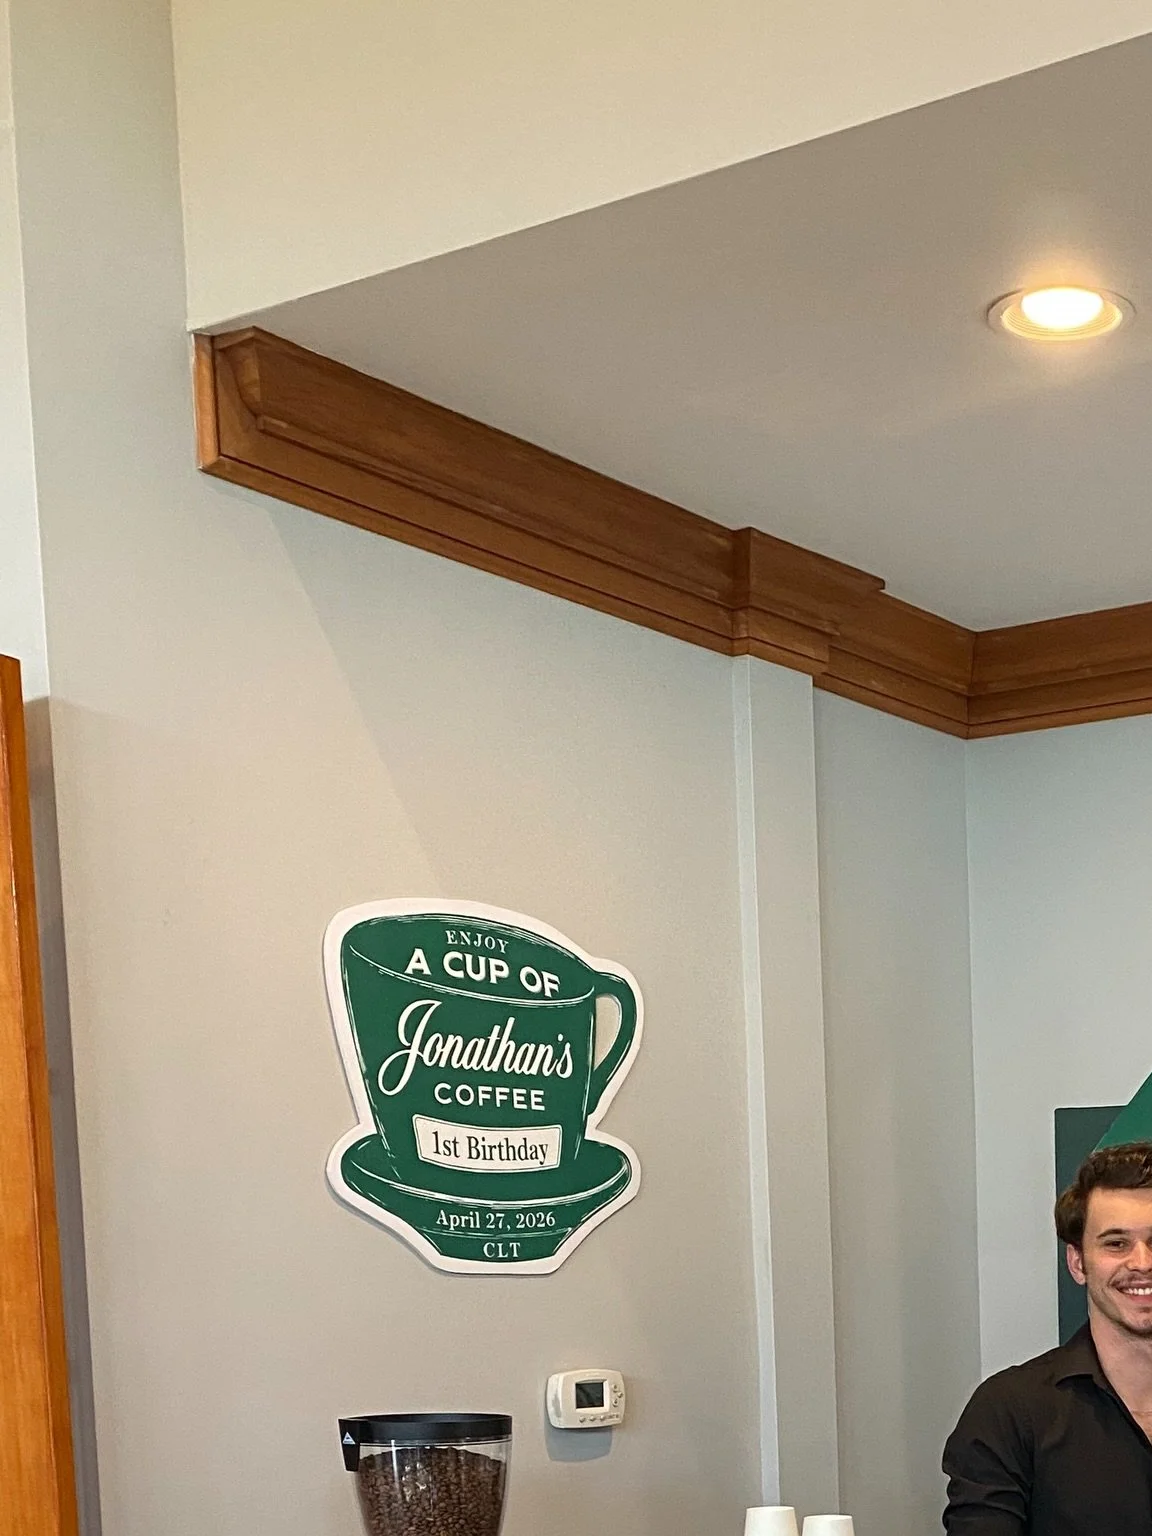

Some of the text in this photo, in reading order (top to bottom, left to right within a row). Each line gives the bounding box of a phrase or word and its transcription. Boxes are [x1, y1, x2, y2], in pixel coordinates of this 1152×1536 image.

[445, 930, 510, 954] ENJOY
[404, 948, 561, 998] A CUP OF
[378, 999, 573, 1096] Jonathan's
[434, 1082, 546, 1111] COFFEE
[432, 1131, 549, 1165] 1st Birthday
[436, 1209, 556, 1231] April 27, 2026
[483, 1242, 521, 1258] CLT
